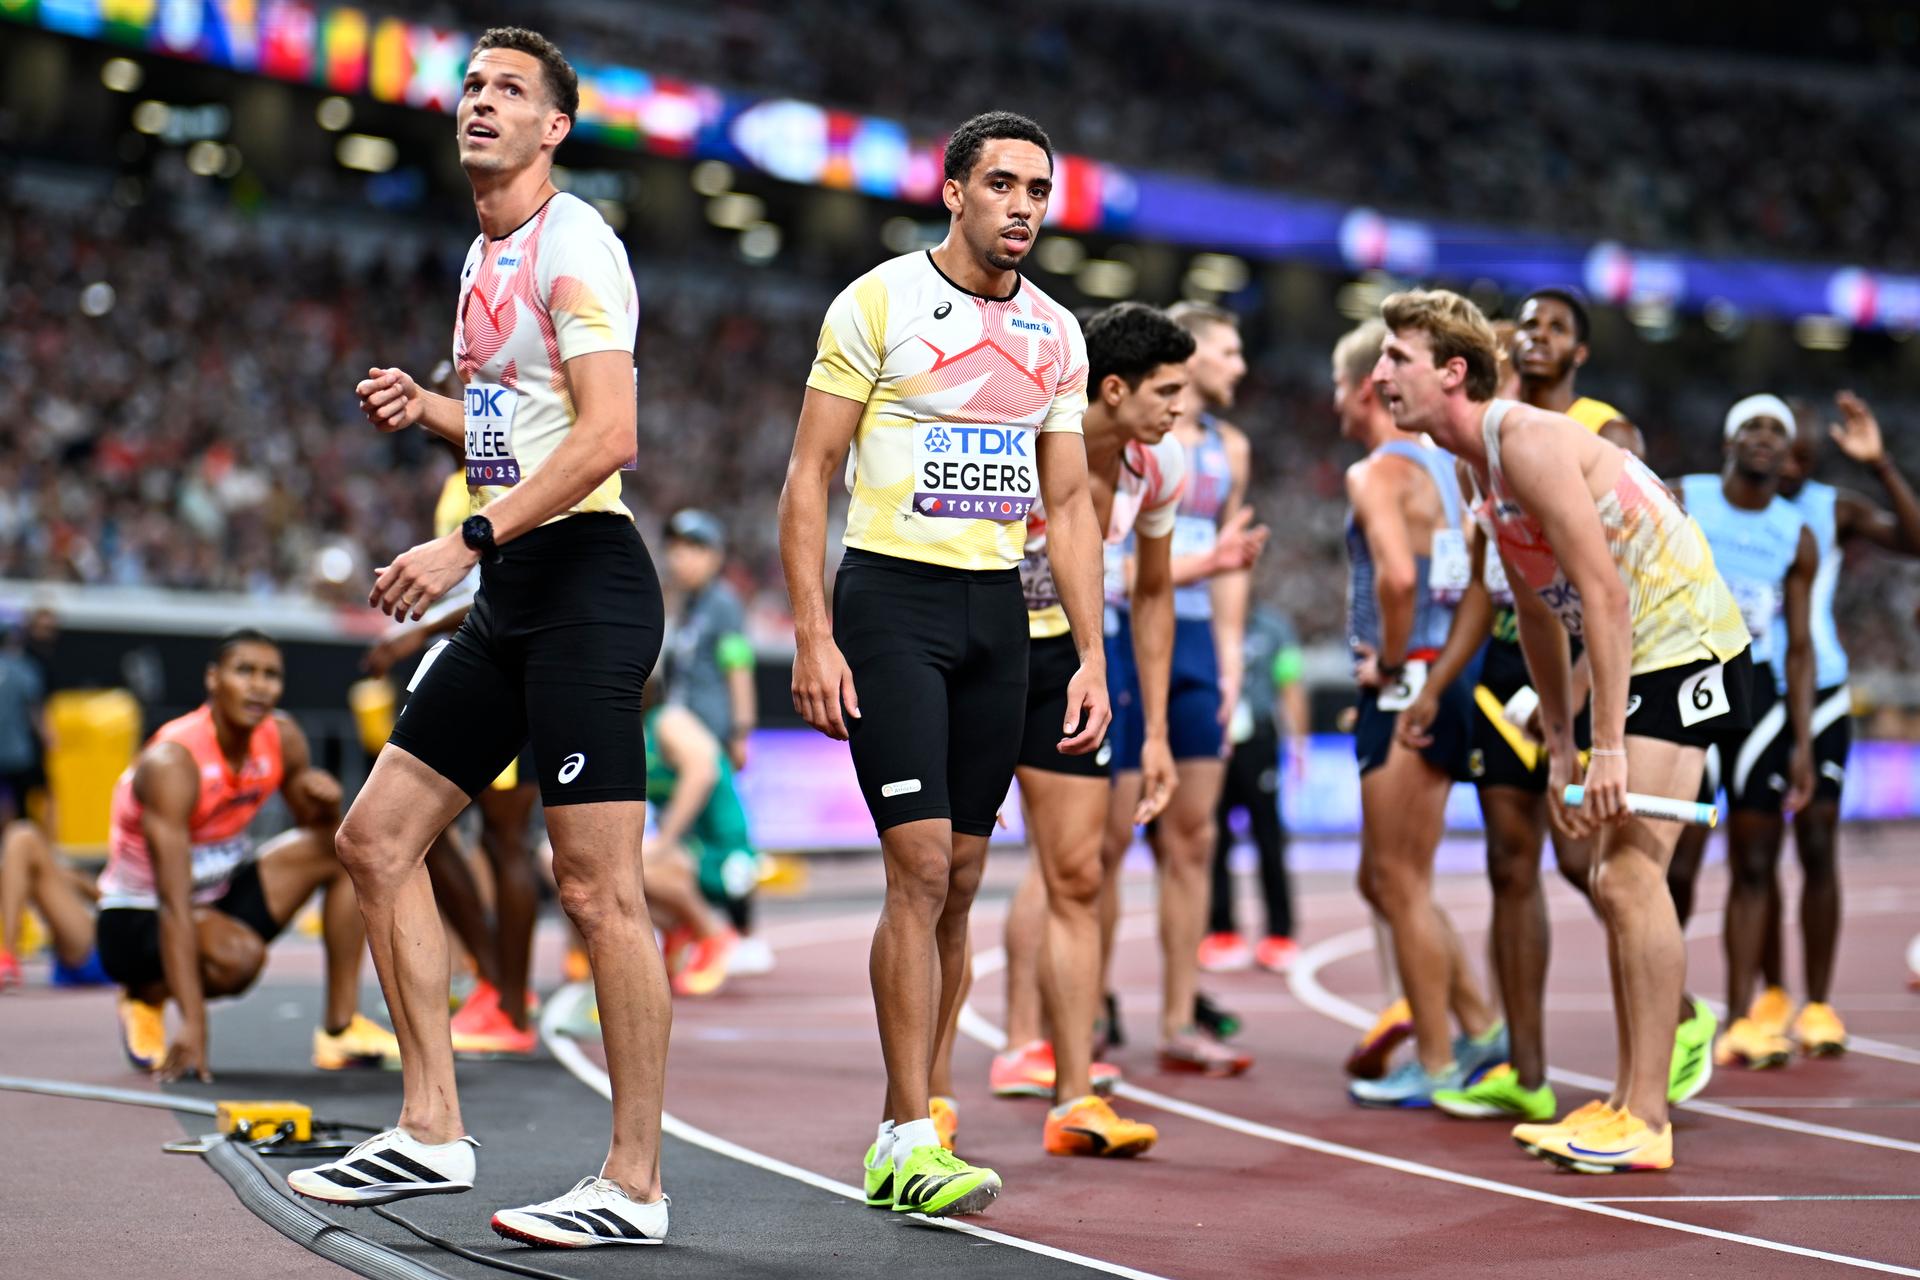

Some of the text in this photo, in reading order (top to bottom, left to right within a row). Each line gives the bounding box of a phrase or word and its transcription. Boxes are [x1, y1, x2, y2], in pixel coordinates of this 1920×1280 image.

[1012, 318, 1041, 331] Allianz
[466, 388, 508, 417] TDK
[465, 424, 510, 457] RLÉE
[951, 427, 1027, 457] TDK
[923, 461, 1031, 493] SEGERS
[1692, 675, 1713, 711] 6
